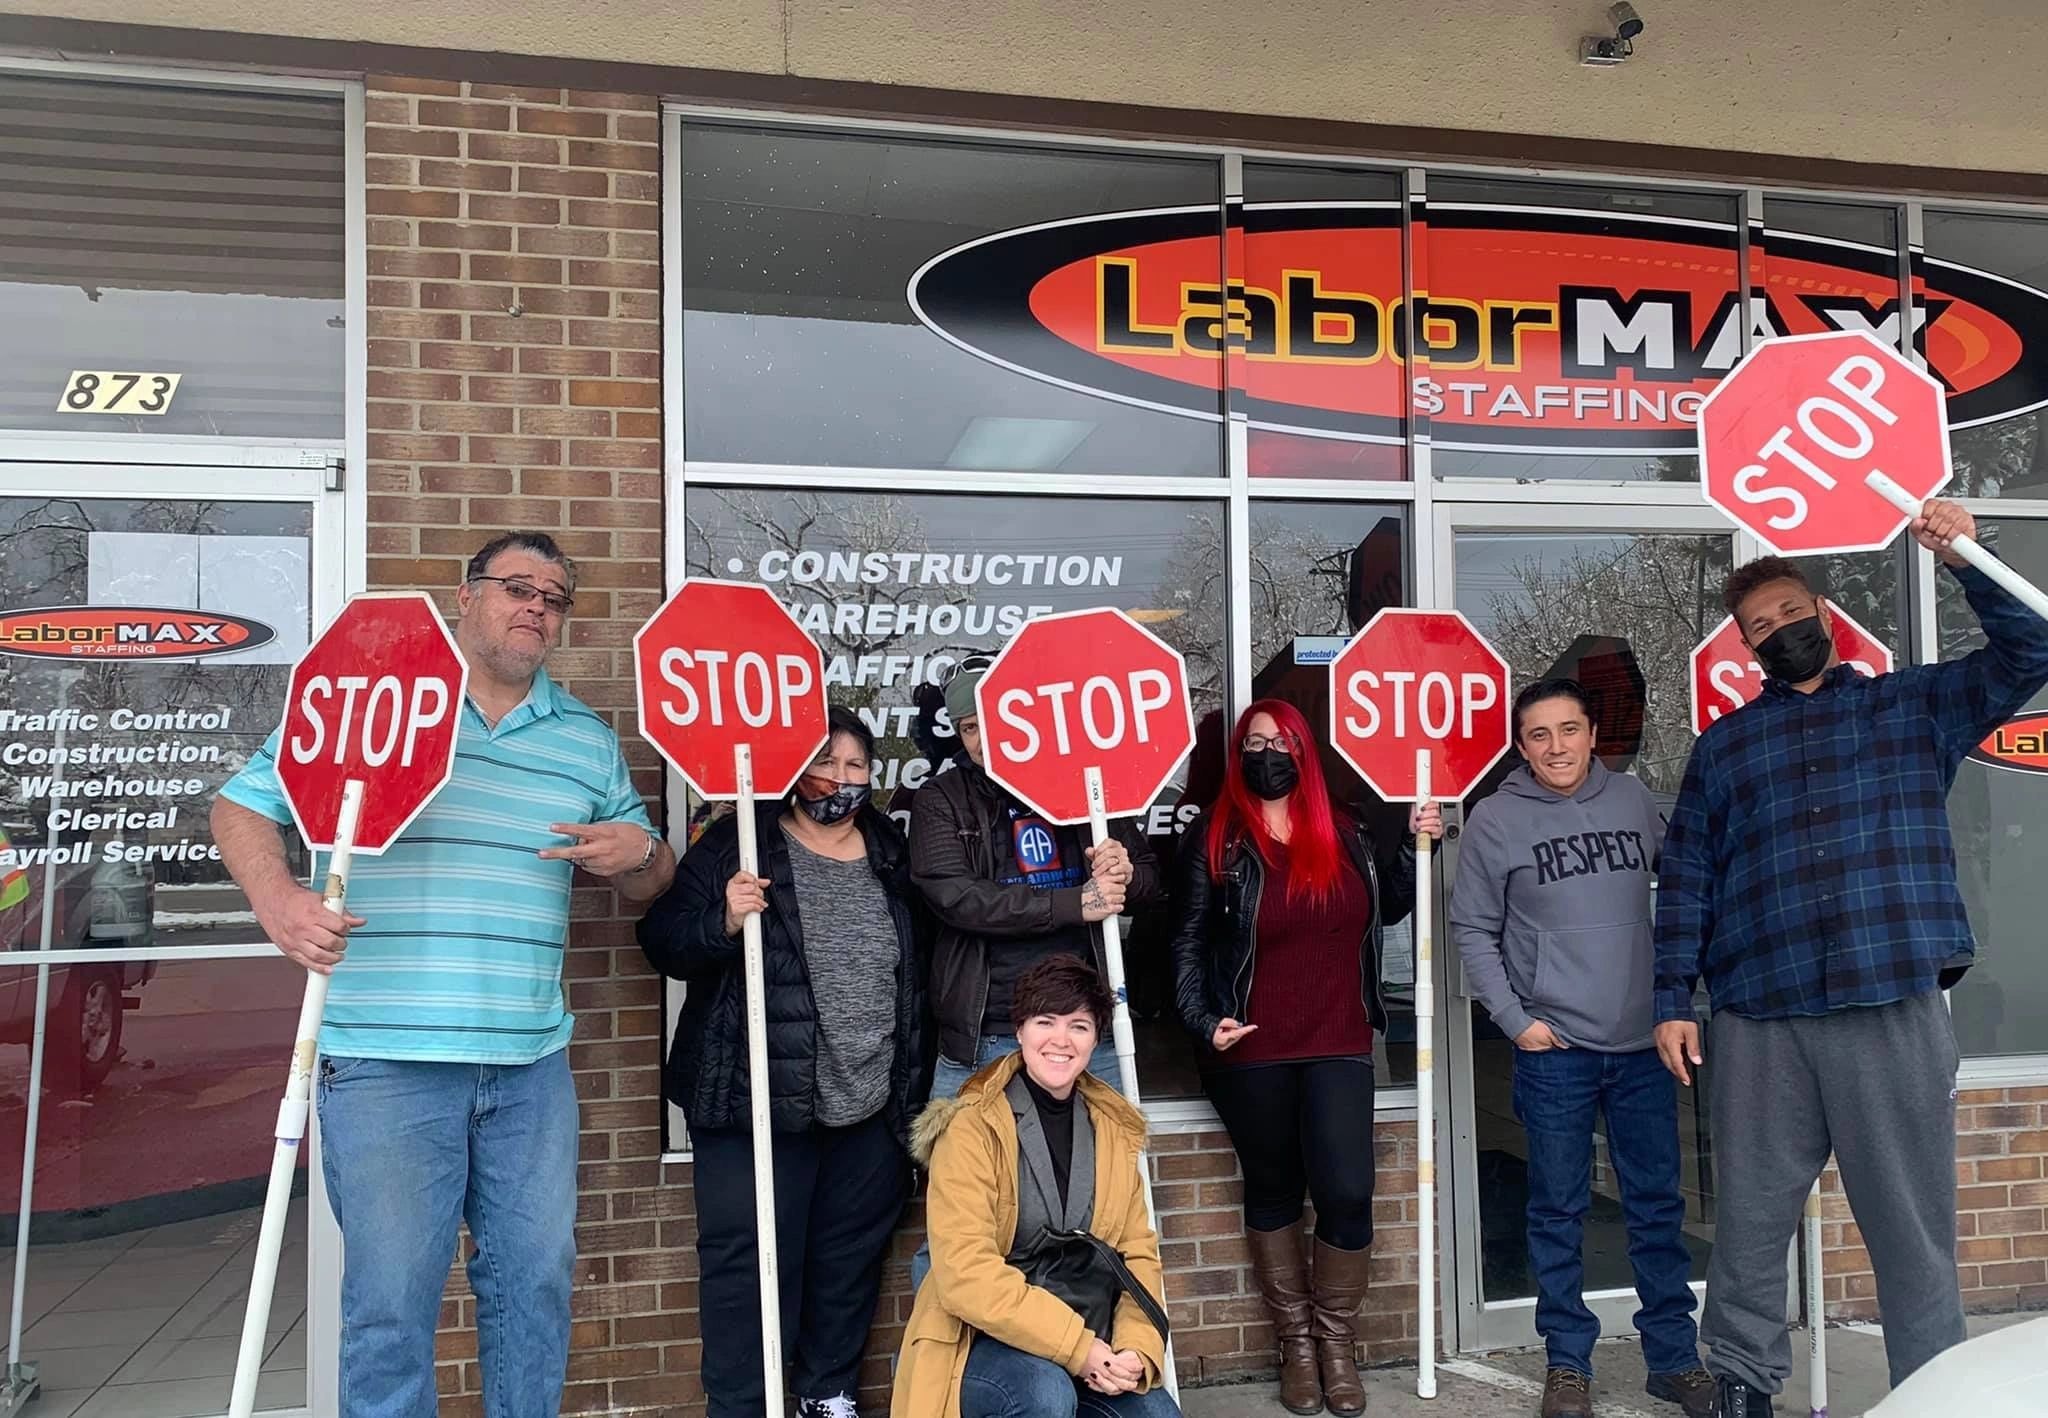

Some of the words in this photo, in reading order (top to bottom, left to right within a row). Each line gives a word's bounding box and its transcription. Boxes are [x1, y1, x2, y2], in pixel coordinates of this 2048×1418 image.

[66, 373, 171, 412] 873
[1413, 376, 1704, 423] STAFFING
[1732, 354, 1899, 531] STOP
[757, 551, 1123, 586] CONSTRUCTION
[784, 603, 1053, 636] AREHOUS
[70, 645, 157, 655] STAFFING
[1297, 649, 1332, 659] protected
[660, 647, 812, 728] STOP
[1344, 670, 1496, 739] STOP
[0, 709, 98, 731] Traffic
[110, 708, 231, 731] Control
[291, 675, 448, 767] STOP
[850, 707, 920, 738] NT
[997, 668, 1172, 764] STOP
[2, 741, 219, 765] Construction
[21, 775, 203, 799] Warehouse
[47, 807, 178, 831] Clerical
[1531, 830, 1648, 885] RESPECT
